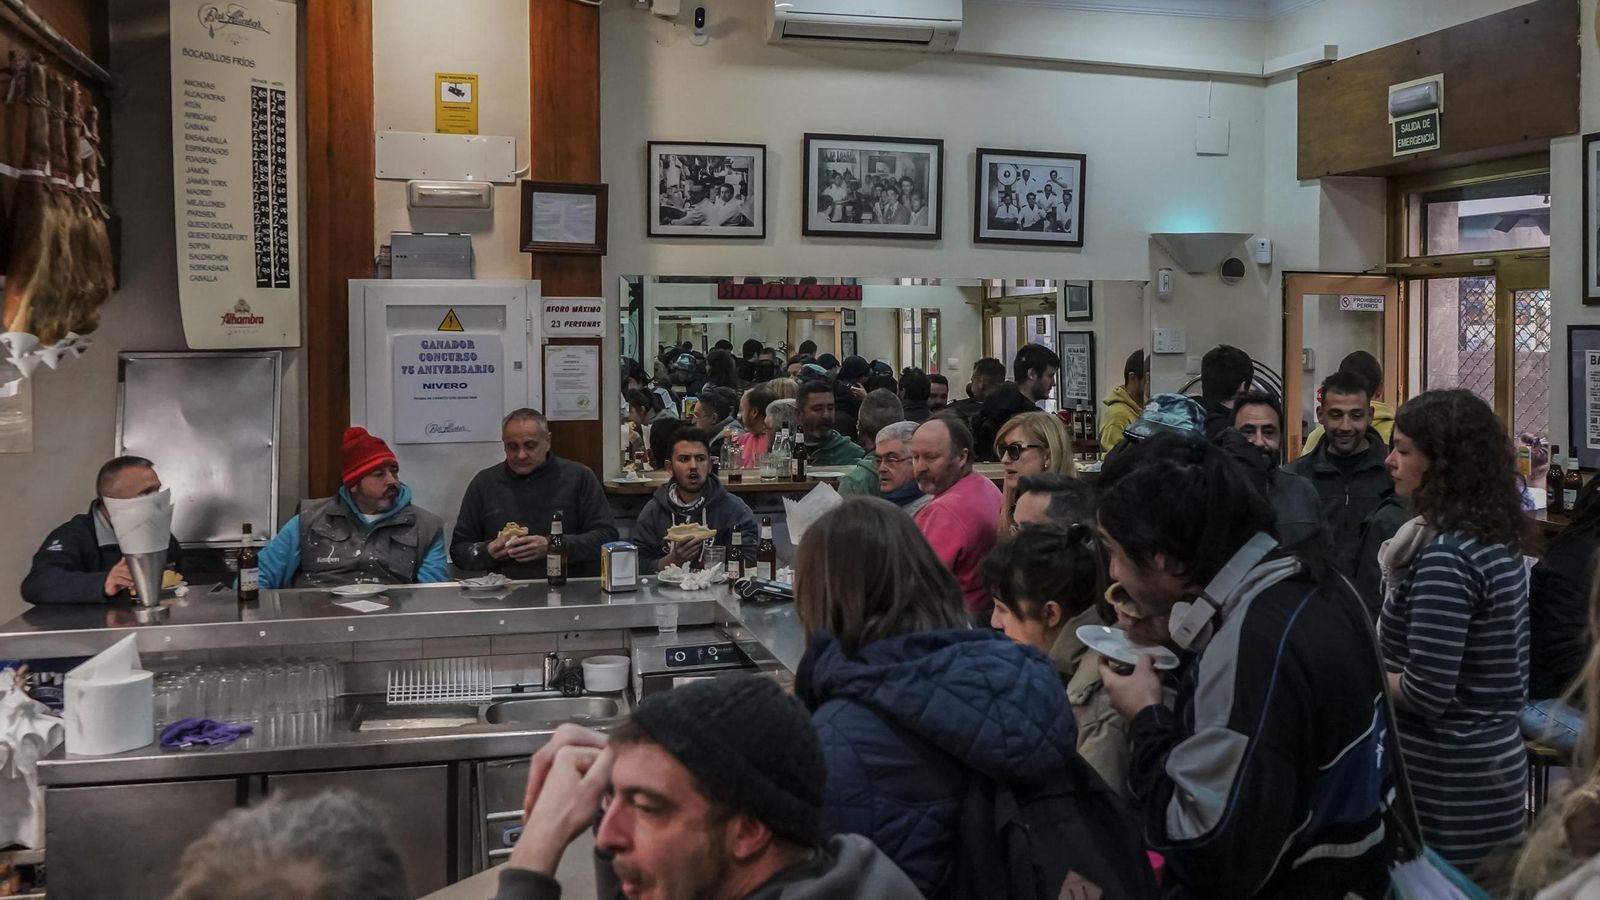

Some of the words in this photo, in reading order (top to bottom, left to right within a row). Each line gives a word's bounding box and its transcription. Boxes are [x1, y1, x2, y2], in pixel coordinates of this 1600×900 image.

[182, 48, 231, 64] BOCADILLOS
[184, 80, 215, 89] ANCHOAS
[184, 91, 225, 102] ALCACHOFAS
[1400, 121, 1421, 133] SALIDA
[1422, 118, 1431, 128] DE
[185, 134, 228, 144] ENSALADILLA
[1398, 133, 1435, 148] EMERGENCIA
[186, 199, 226, 208] MEJILLONES
[210, 222, 233, 230] GOUDA
[189, 264, 229, 272] SOBRASADA
[190, 274, 218, 282] CABALLA
[572, 304, 601, 313] MÁXIMO
[221, 312, 264, 326] Alhambra
[551, 320, 561, 328] 23
[420, 340, 475, 350] GANADOR
[419, 352, 478, 362] CONCURSO
[401, 366, 415, 375] 75
[418, 365, 495, 375] ANIVERSARIO
[422, 382, 468, 390] NIVERO
